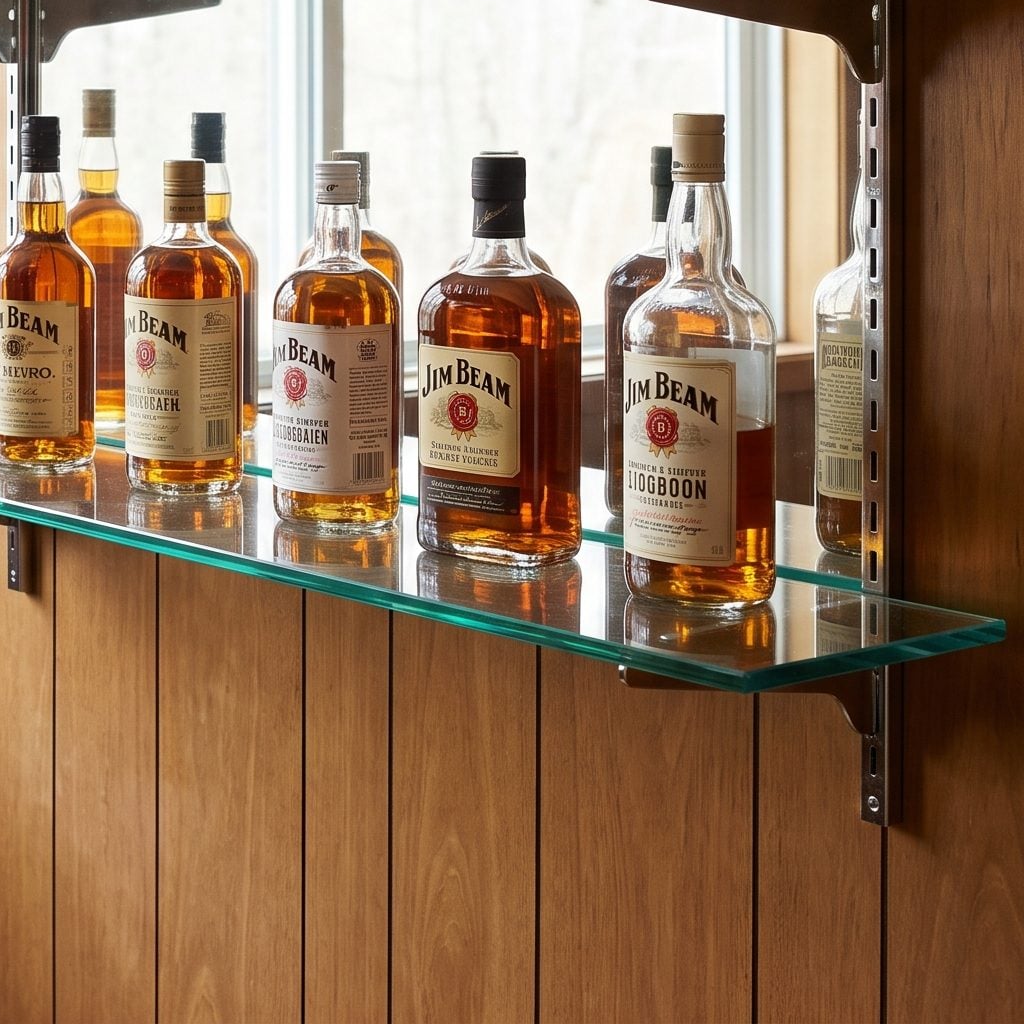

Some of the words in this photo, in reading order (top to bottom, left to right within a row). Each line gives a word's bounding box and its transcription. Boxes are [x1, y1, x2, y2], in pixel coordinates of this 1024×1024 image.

[7, 305, 60, 345] BEAM
[138, 309, 188, 354] BEAM
[288, 337, 337, 383] BEAM
[422, 363, 453, 398] JIM
[456, 358, 513, 409] BEAM
[625, 377, 651, 414] JIM
[655, 371, 719, 425] BEAM
[657, 422, 665, 433] B
